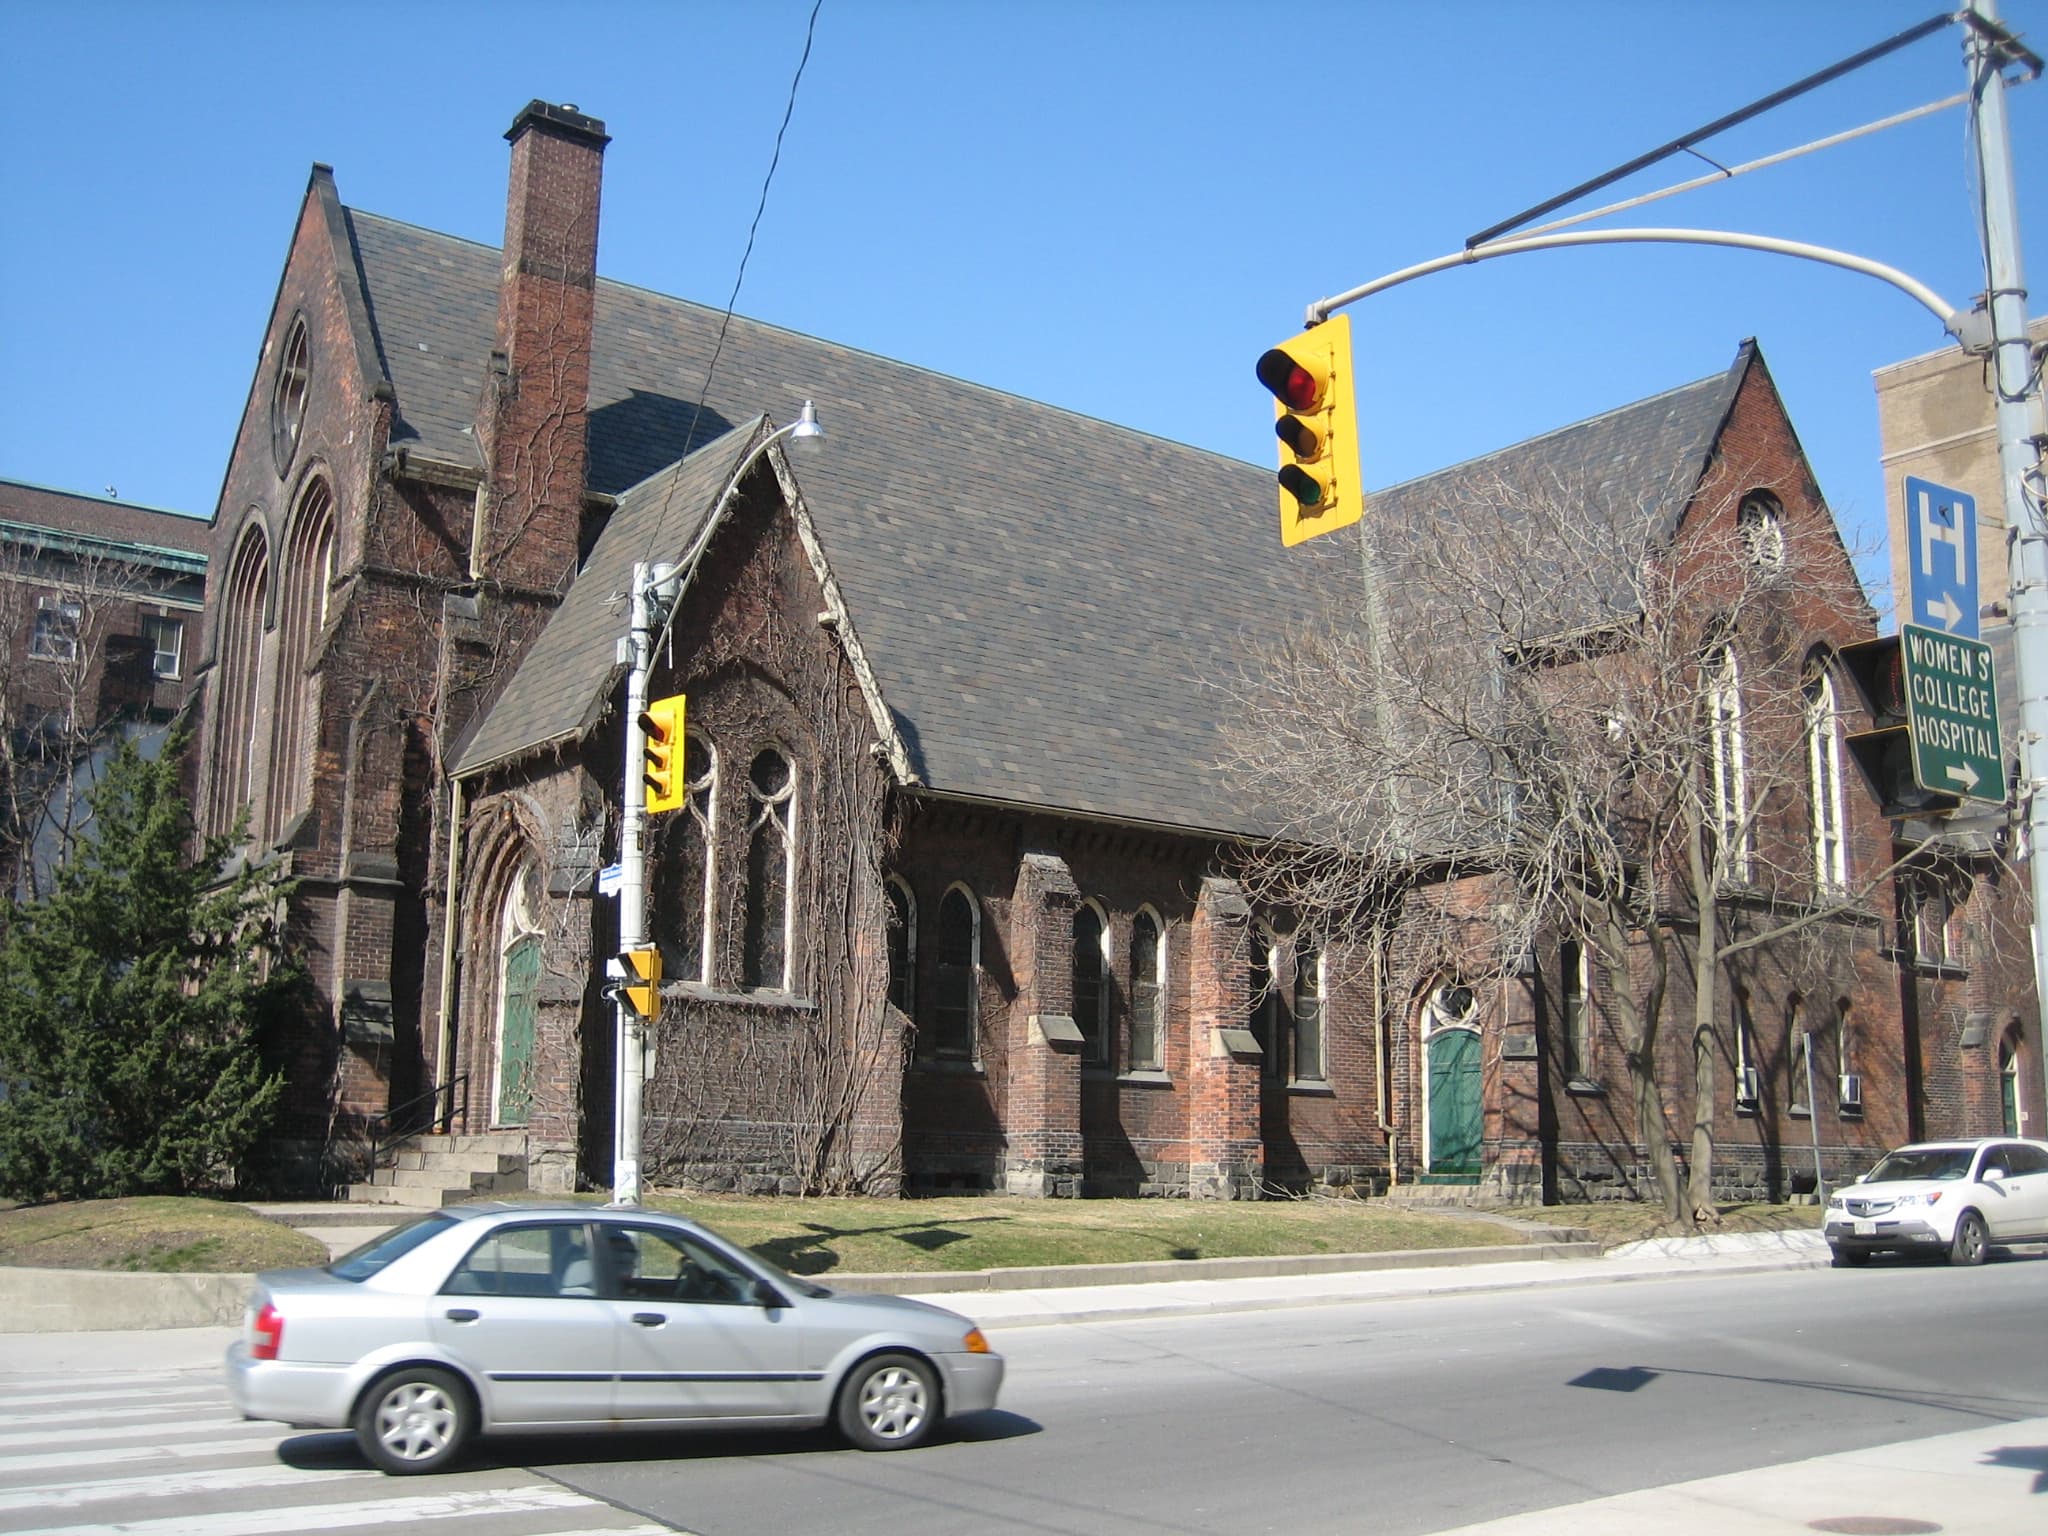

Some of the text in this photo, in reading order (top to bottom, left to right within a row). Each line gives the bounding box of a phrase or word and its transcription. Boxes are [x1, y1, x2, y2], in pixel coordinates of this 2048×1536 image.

[1919, 491, 1966, 585] H
[1913, 673, 1991, 719] COLLEGE
[1916, 714, 1998, 759] HOSPITAL
